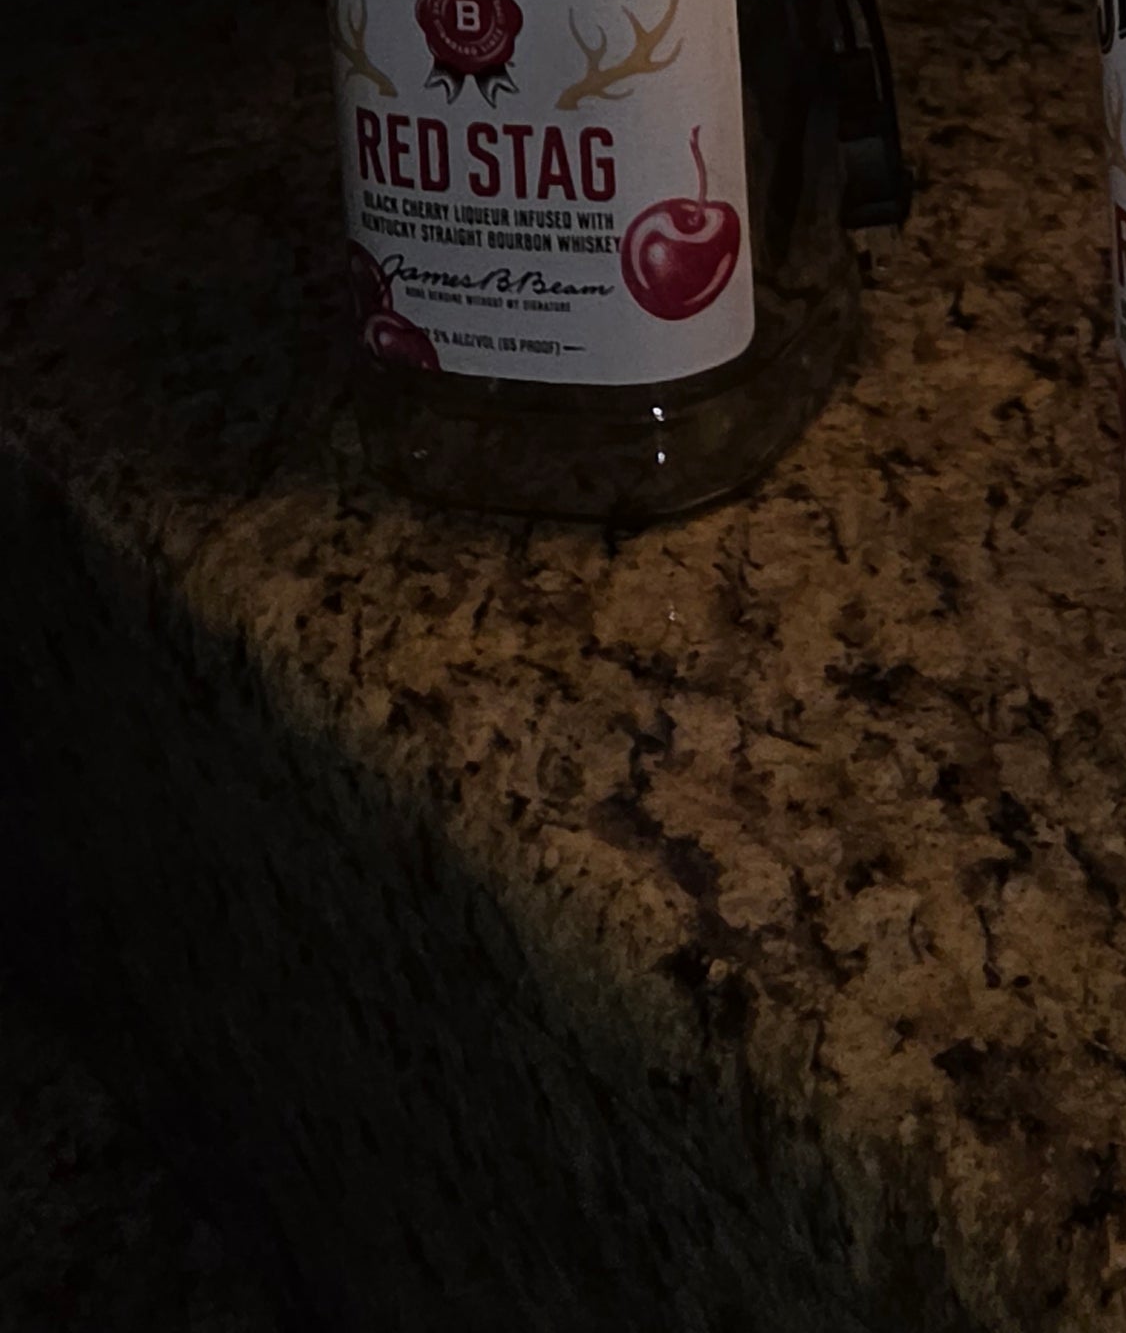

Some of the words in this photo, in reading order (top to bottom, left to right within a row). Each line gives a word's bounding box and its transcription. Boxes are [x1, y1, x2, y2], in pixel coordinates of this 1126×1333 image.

[456, 0, 481, 32] B
[354, 105, 451, 194] RED
[465, 120, 618, 203] STAG
[402, 198, 449, 222] CHERRY
[453, 204, 510, 227] LIQUEUR
[514, 209, 572, 230] INFUSED
[576, 212, 615, 232] WITH
[420, 223, 483, 248] STRAIGHT
[487, 231, 553, 253] BOURBON
[557, 235, 621, 254] WHISKEY
[379, 253, 474, 289] James
[514, 270, 616, 297] Beam
